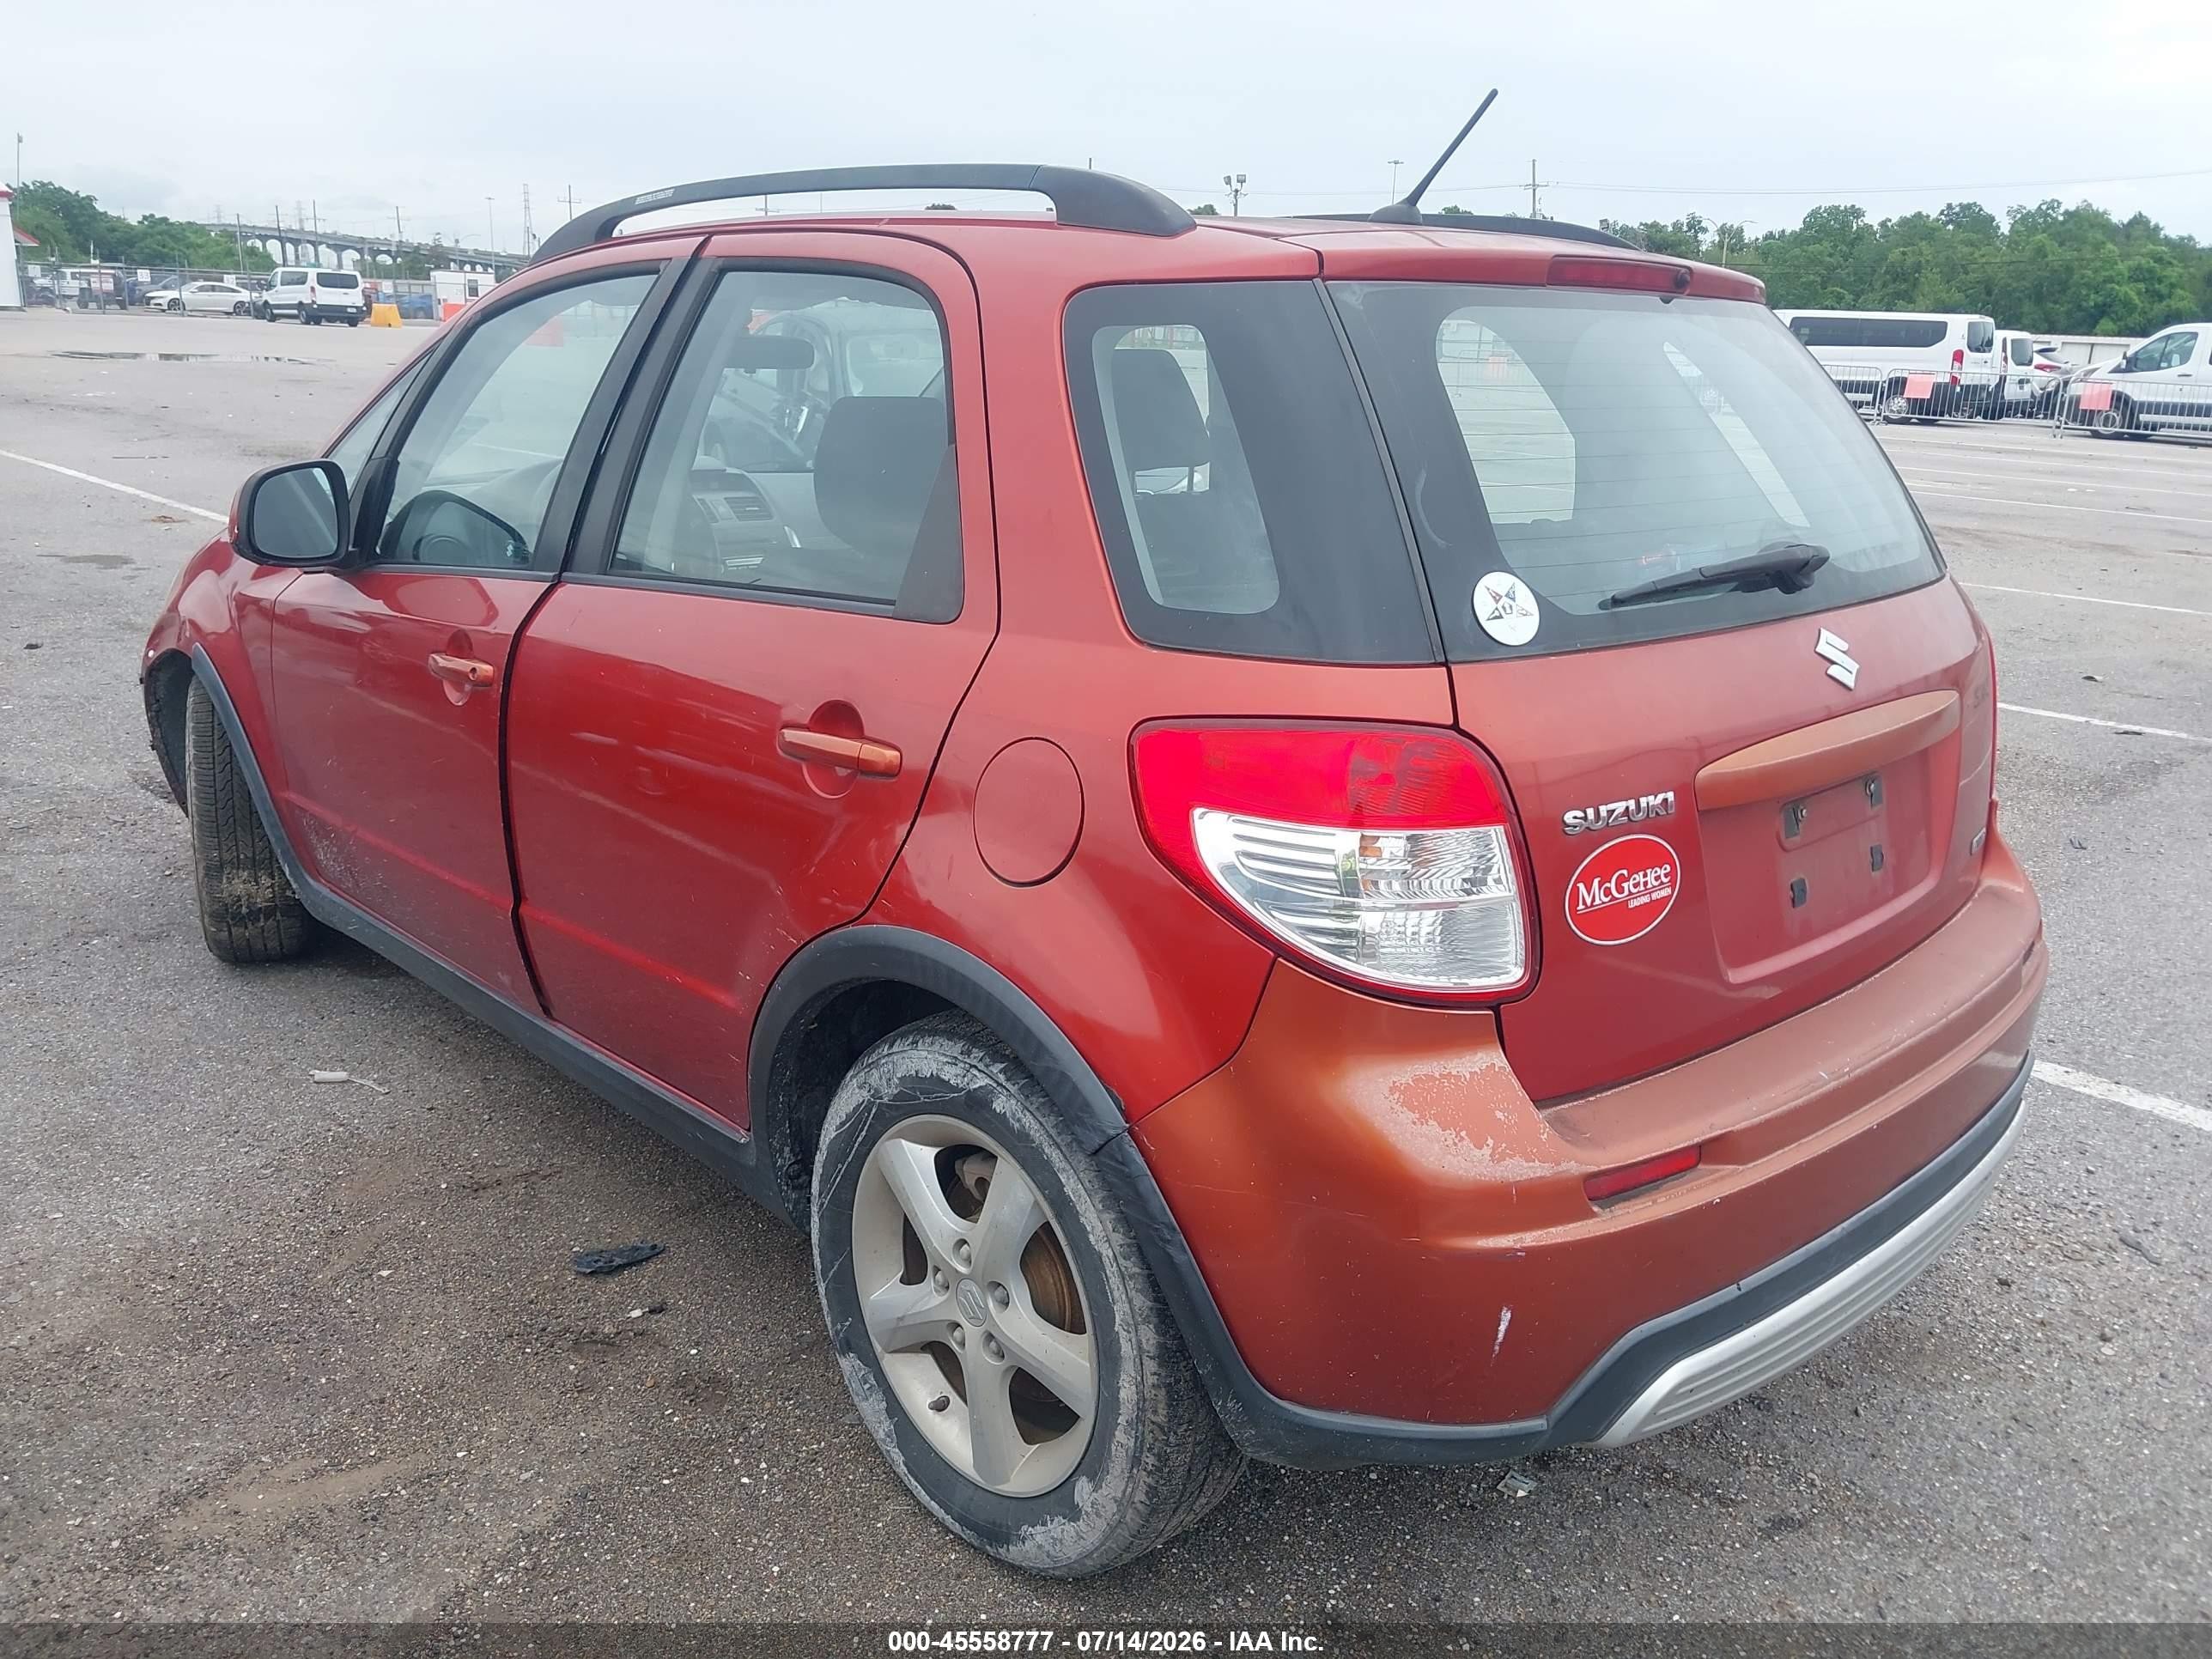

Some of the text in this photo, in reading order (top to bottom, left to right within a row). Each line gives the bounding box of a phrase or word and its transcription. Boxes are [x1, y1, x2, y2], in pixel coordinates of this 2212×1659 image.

[1563, 791, 1674, 835] SUZUKI
[1627, 886, 1672, 908] LEADING WOMEN
